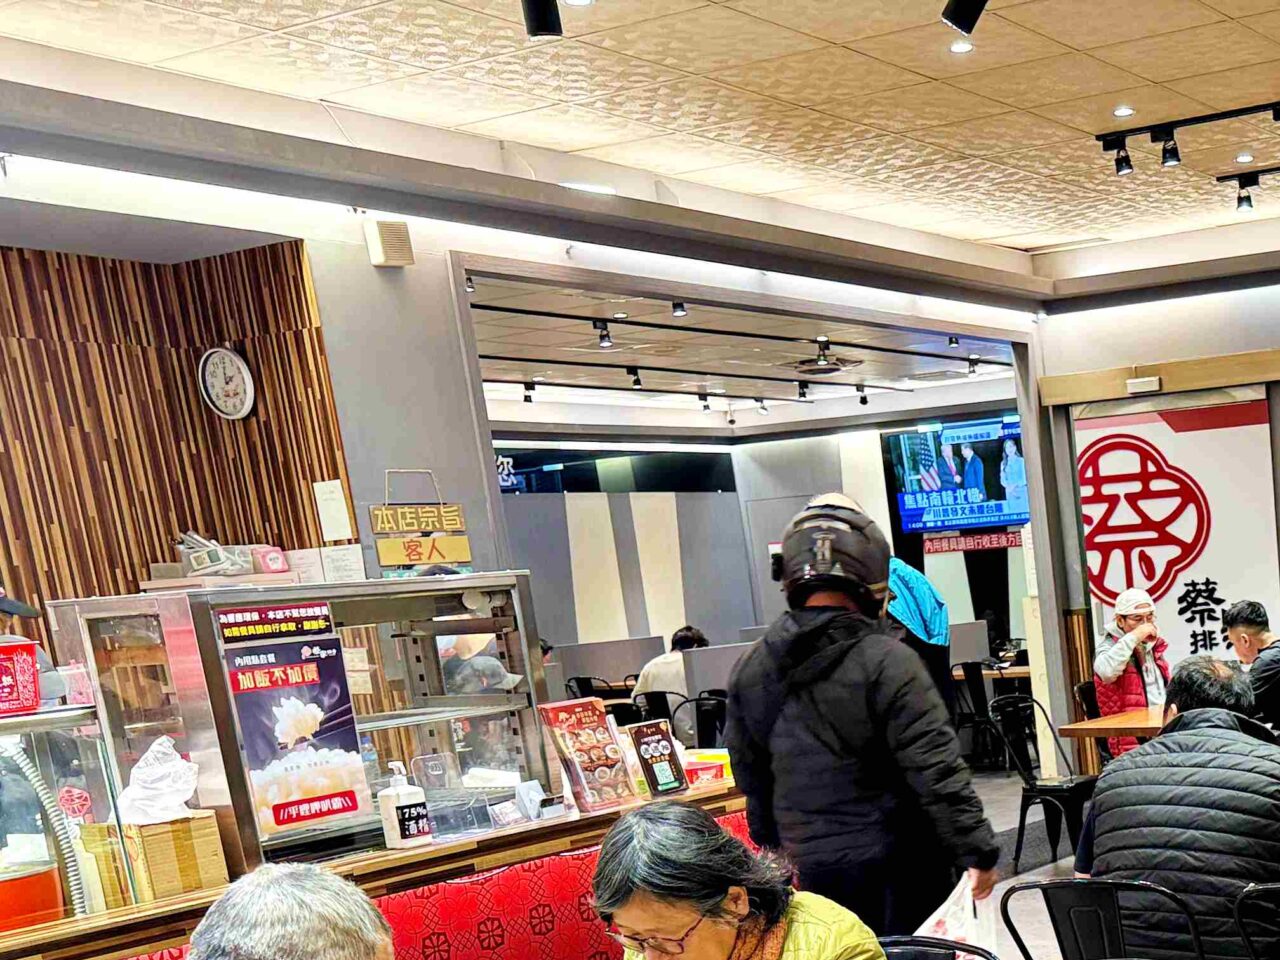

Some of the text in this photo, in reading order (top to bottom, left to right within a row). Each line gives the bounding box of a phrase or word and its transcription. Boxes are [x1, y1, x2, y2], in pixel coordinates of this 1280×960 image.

[375, 506, 462, 531] 本店宗旨
[403, 538, 446, 562] 客人
[238, 663, 319, 690] 加飯不加價
[403, 806, 427, 818] 75%
